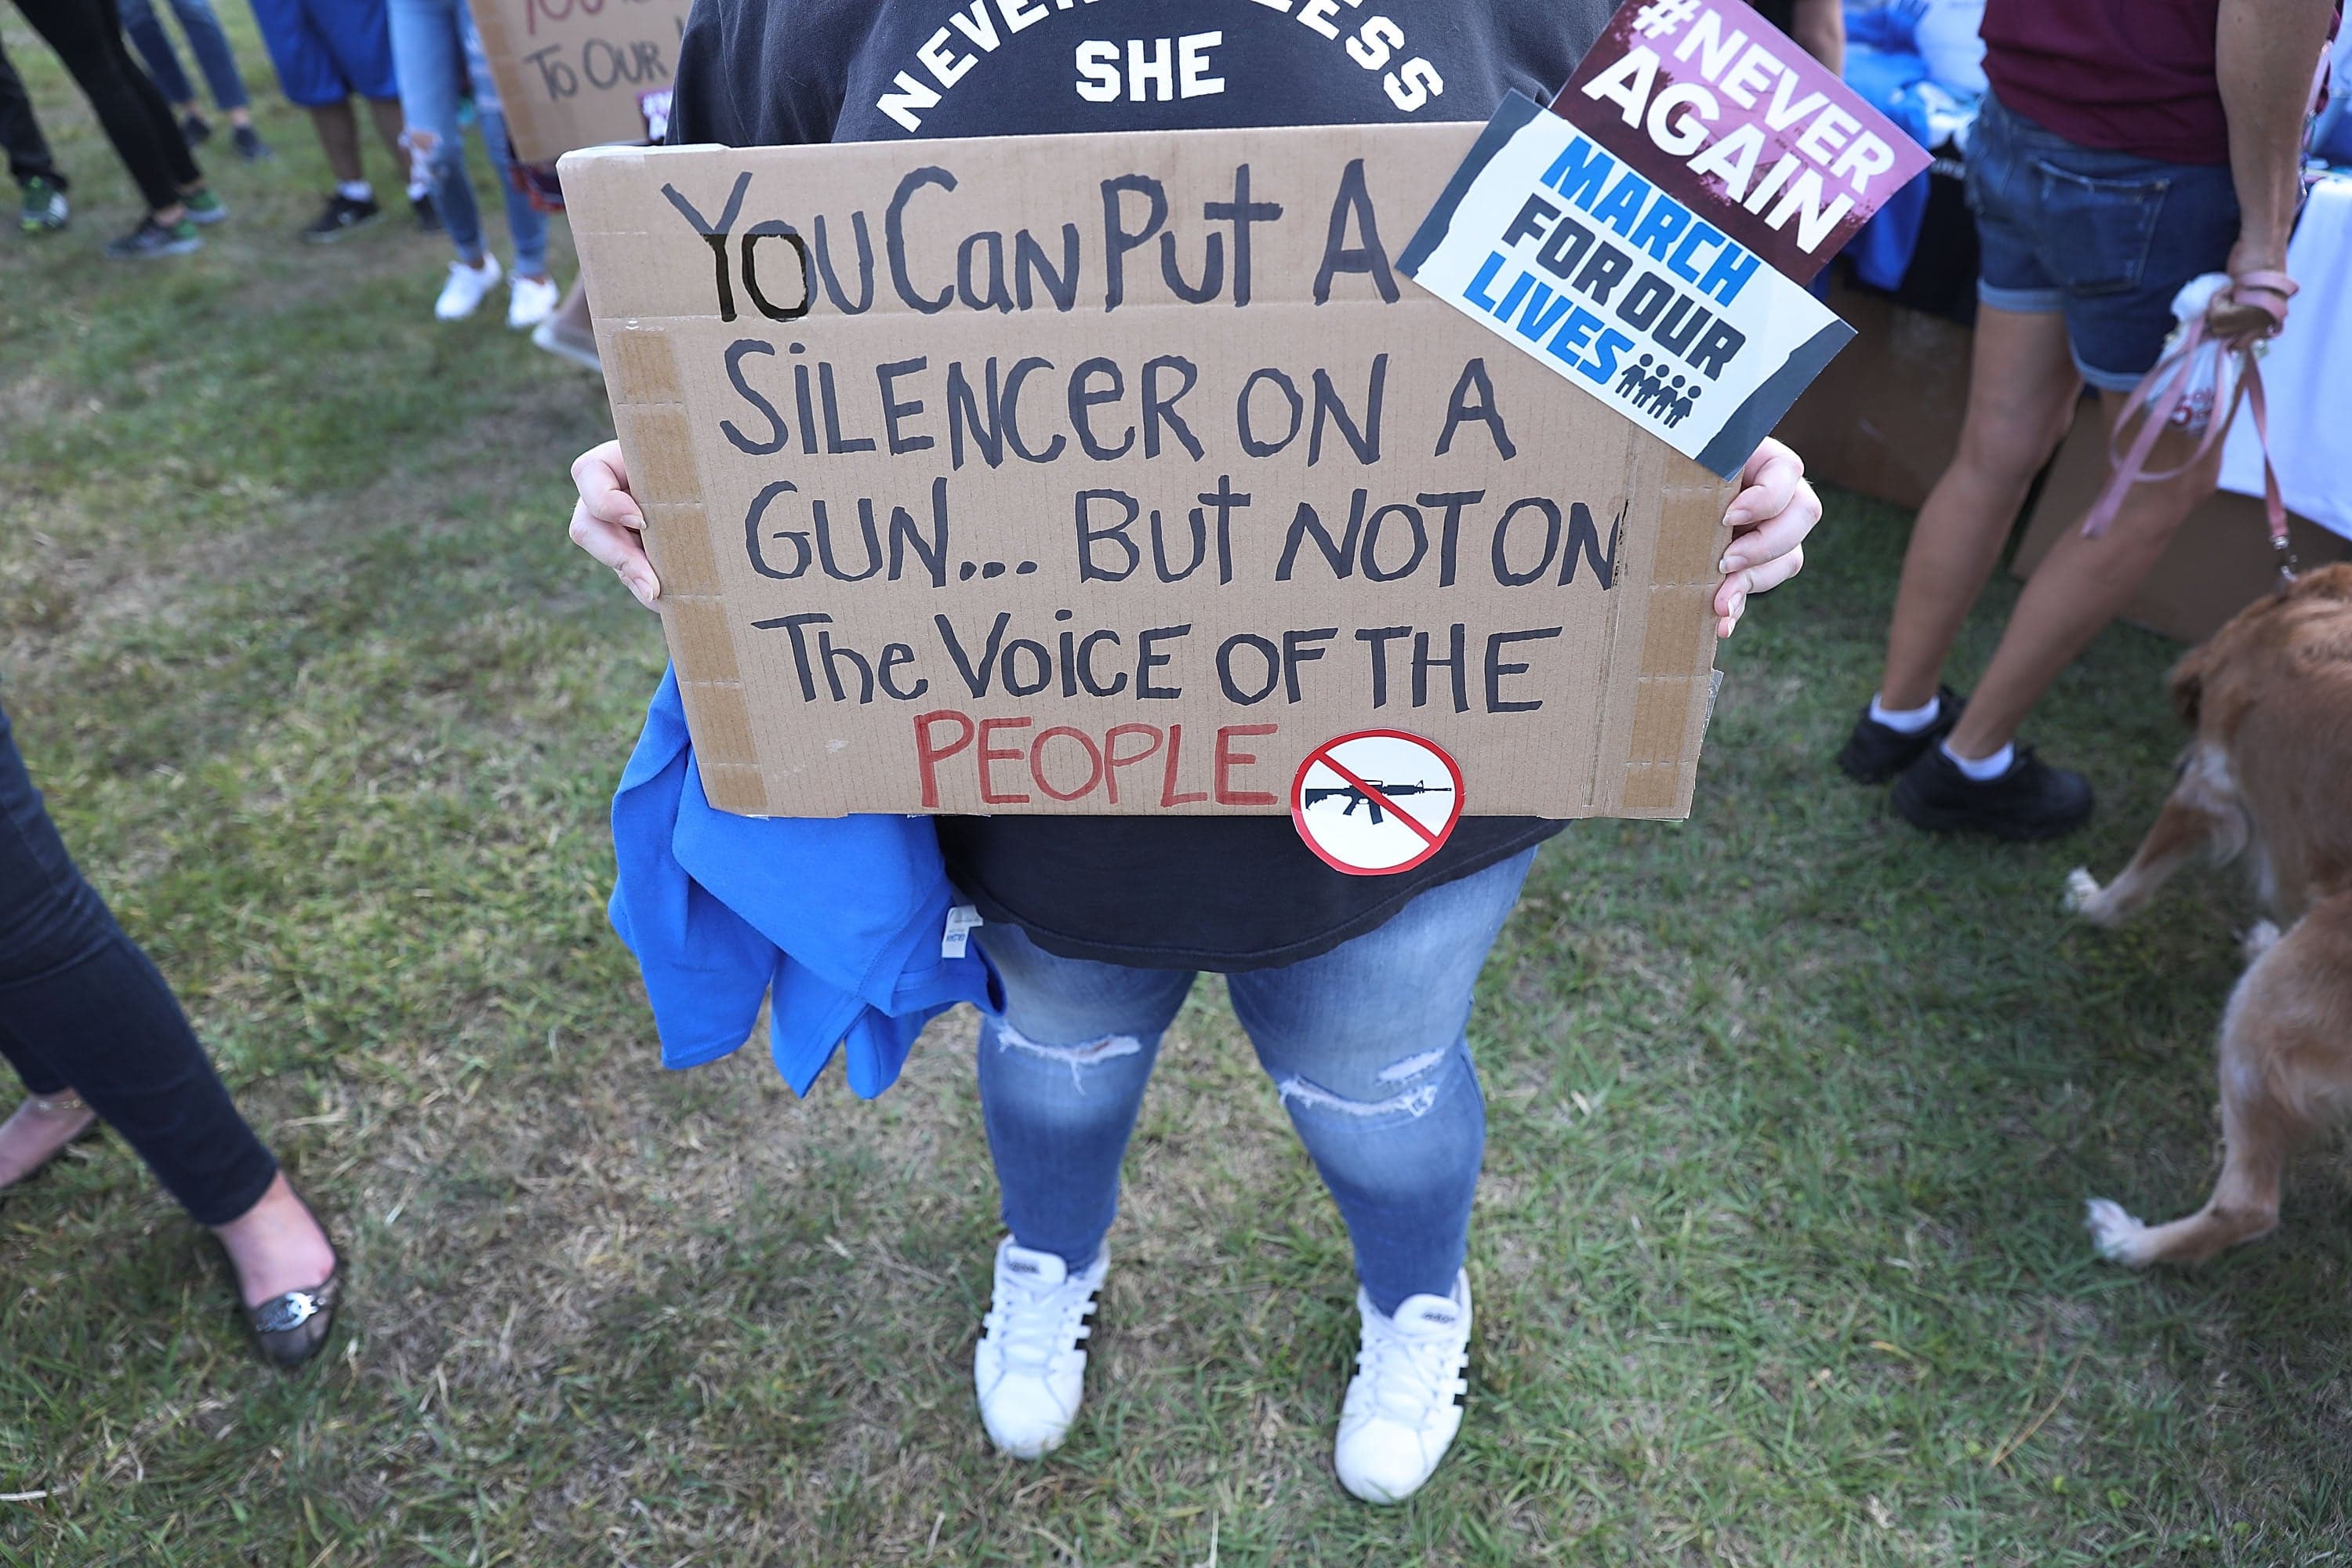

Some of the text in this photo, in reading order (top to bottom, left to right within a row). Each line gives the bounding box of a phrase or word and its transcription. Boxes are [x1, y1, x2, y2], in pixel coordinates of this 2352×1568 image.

[583, 38, 669, 91] OUR
[1076, 31, 1225, 102] SHE
[1632, 0, 1895, 194] #NEVER
[1581, 45, 1855, 254] AGAIN
[1312, 158, 1401, 305] A
[1539, 136, 1760, 307] MARCH
[1463, 251, 1635, 384] LIVES
[1501, 193, 1746, 381] FOR OUR
[1236, 353, 1388, 467] ON
[1434, 357, 1517, 461] A
[745, 477, 1038, 588] GUN...
[1275, 488, 1486, 588] NOT
[1491, 496, 1629, 591] ON
[750, 612, 928, 704] The
[1215, 627, 1339, 706] OF
[1355, 623, 1563, 713] THE
[913, 710, 1278, 808] PEOPLE
